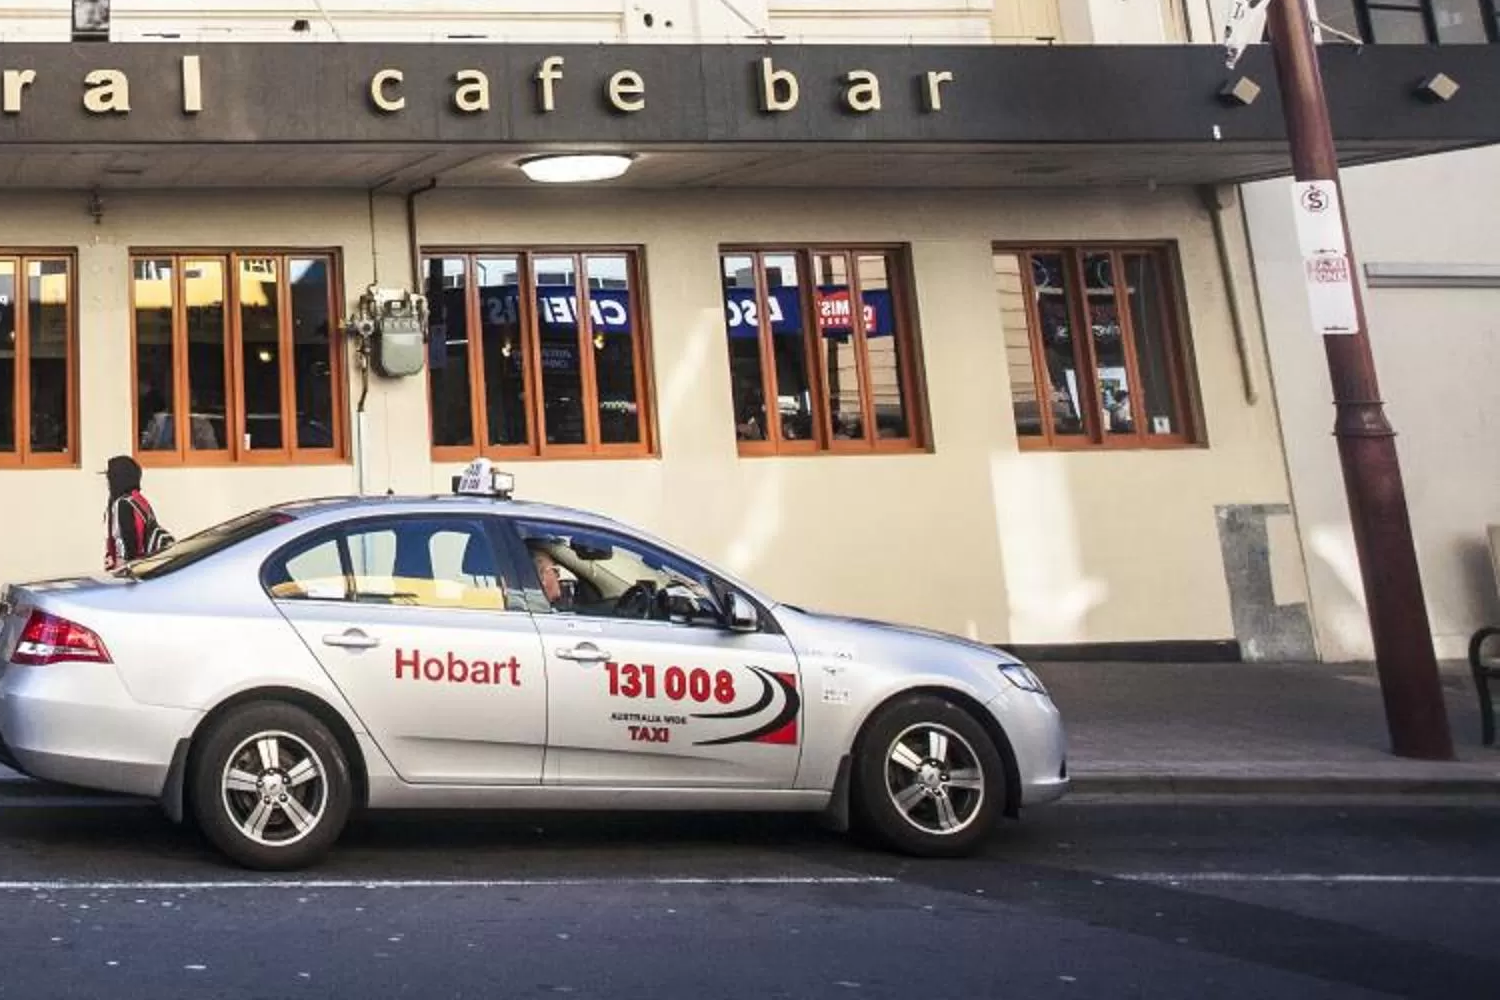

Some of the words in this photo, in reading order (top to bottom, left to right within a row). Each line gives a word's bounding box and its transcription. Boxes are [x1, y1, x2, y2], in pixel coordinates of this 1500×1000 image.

[369, 56, 646, 112] cafe
[760, 56, 953, 112] bar
[394, 648, 521, 686] Hobart
[604, 662, 656, 698] 131
[663, 672, 737, 705] 008
[611, 712, 661, 723] AUSTRALIA
[627, 725, 670, 743] TAXI
